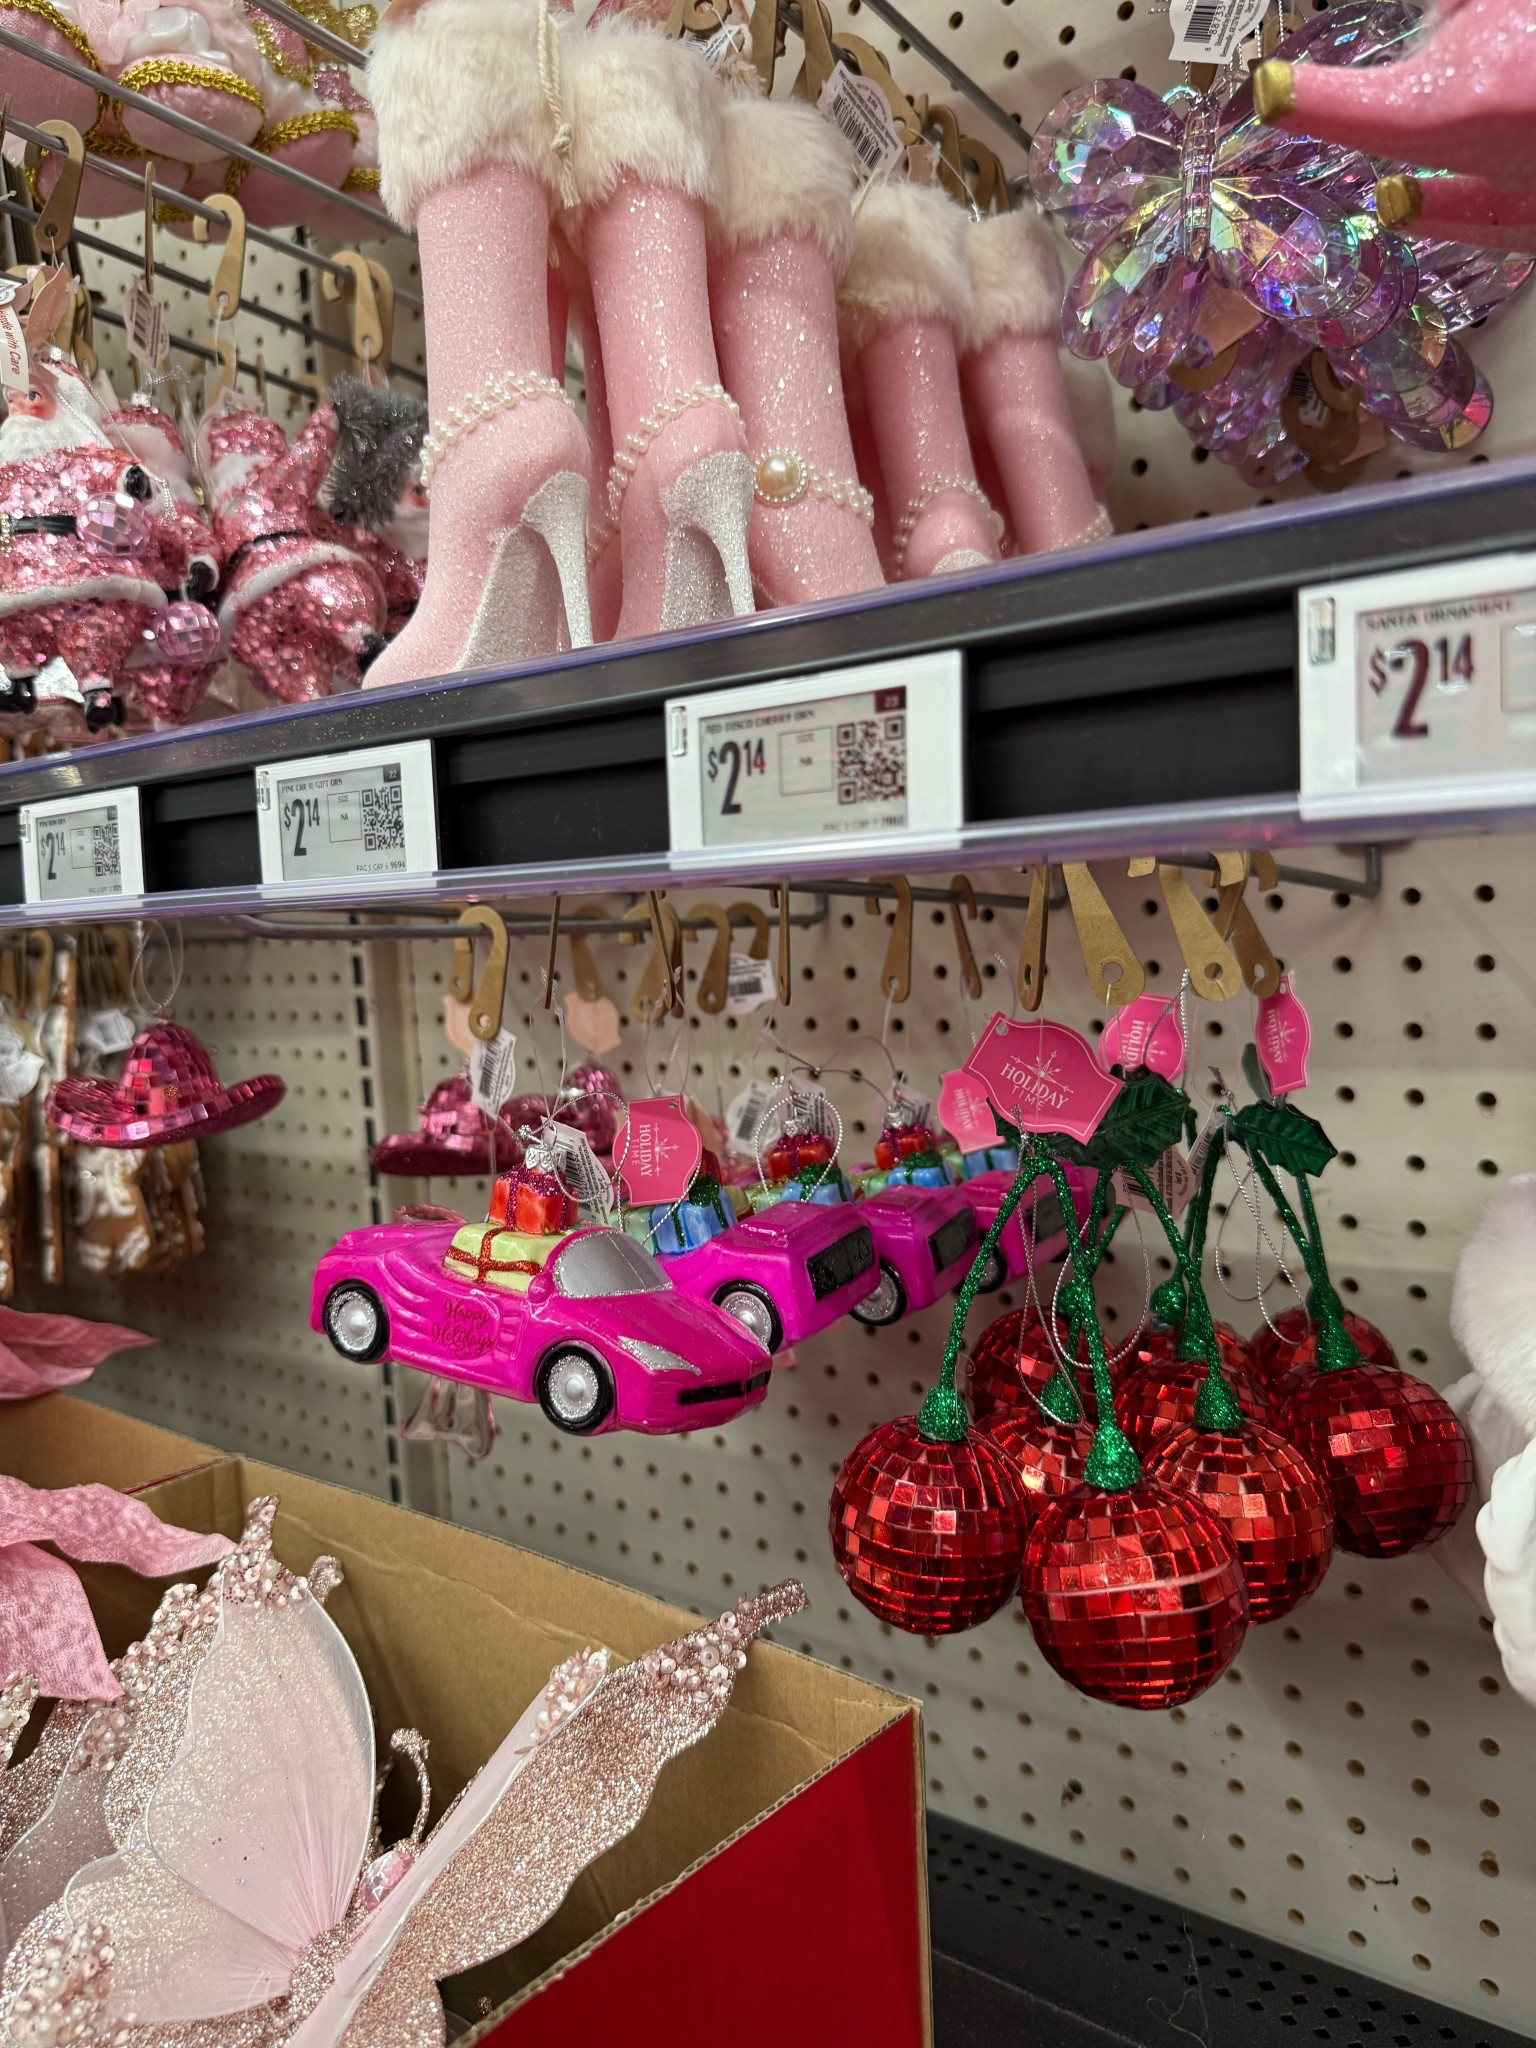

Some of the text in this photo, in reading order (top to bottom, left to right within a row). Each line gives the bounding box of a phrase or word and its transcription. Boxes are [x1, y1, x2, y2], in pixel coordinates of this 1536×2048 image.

[5, 331, 19, 349] with
[10, 351, 21, 375] Care
[1366, 600, 1514, 631] SANTA ORNAMENT
[706, 724, 723, 734] RED
[724, 719, 754, 732] DISCO
[755, 713, 792, 727] CHERRY
[282, 785, 294, 794] PINK
[296, 783, 307, 792] CAR
[330, 778, 343, 787] ORN
[338, 795, 349, 803] SIZE
[340, 813, 349, 821] NA
[356, 865, 368, 873] FAC
[372, 863, 383, 871] CAP
[389, 860, 406, 869] 9694
[1124, 1020, 1144, 1068] HOLIDA
[1268, 1008, 1283, 1063] HOLIDAY
[1000, 1063, 1069, 1110] HOLIDAY
[1012, 1084, 1045, 1111] TIME
[631, 1138, 640, 1166] TIME
[639, 1123, 653, 1177] HOLIDAY
[444, 1299, 487, 1330] Happy
[432, 1322, 492, 1356] Holidays
